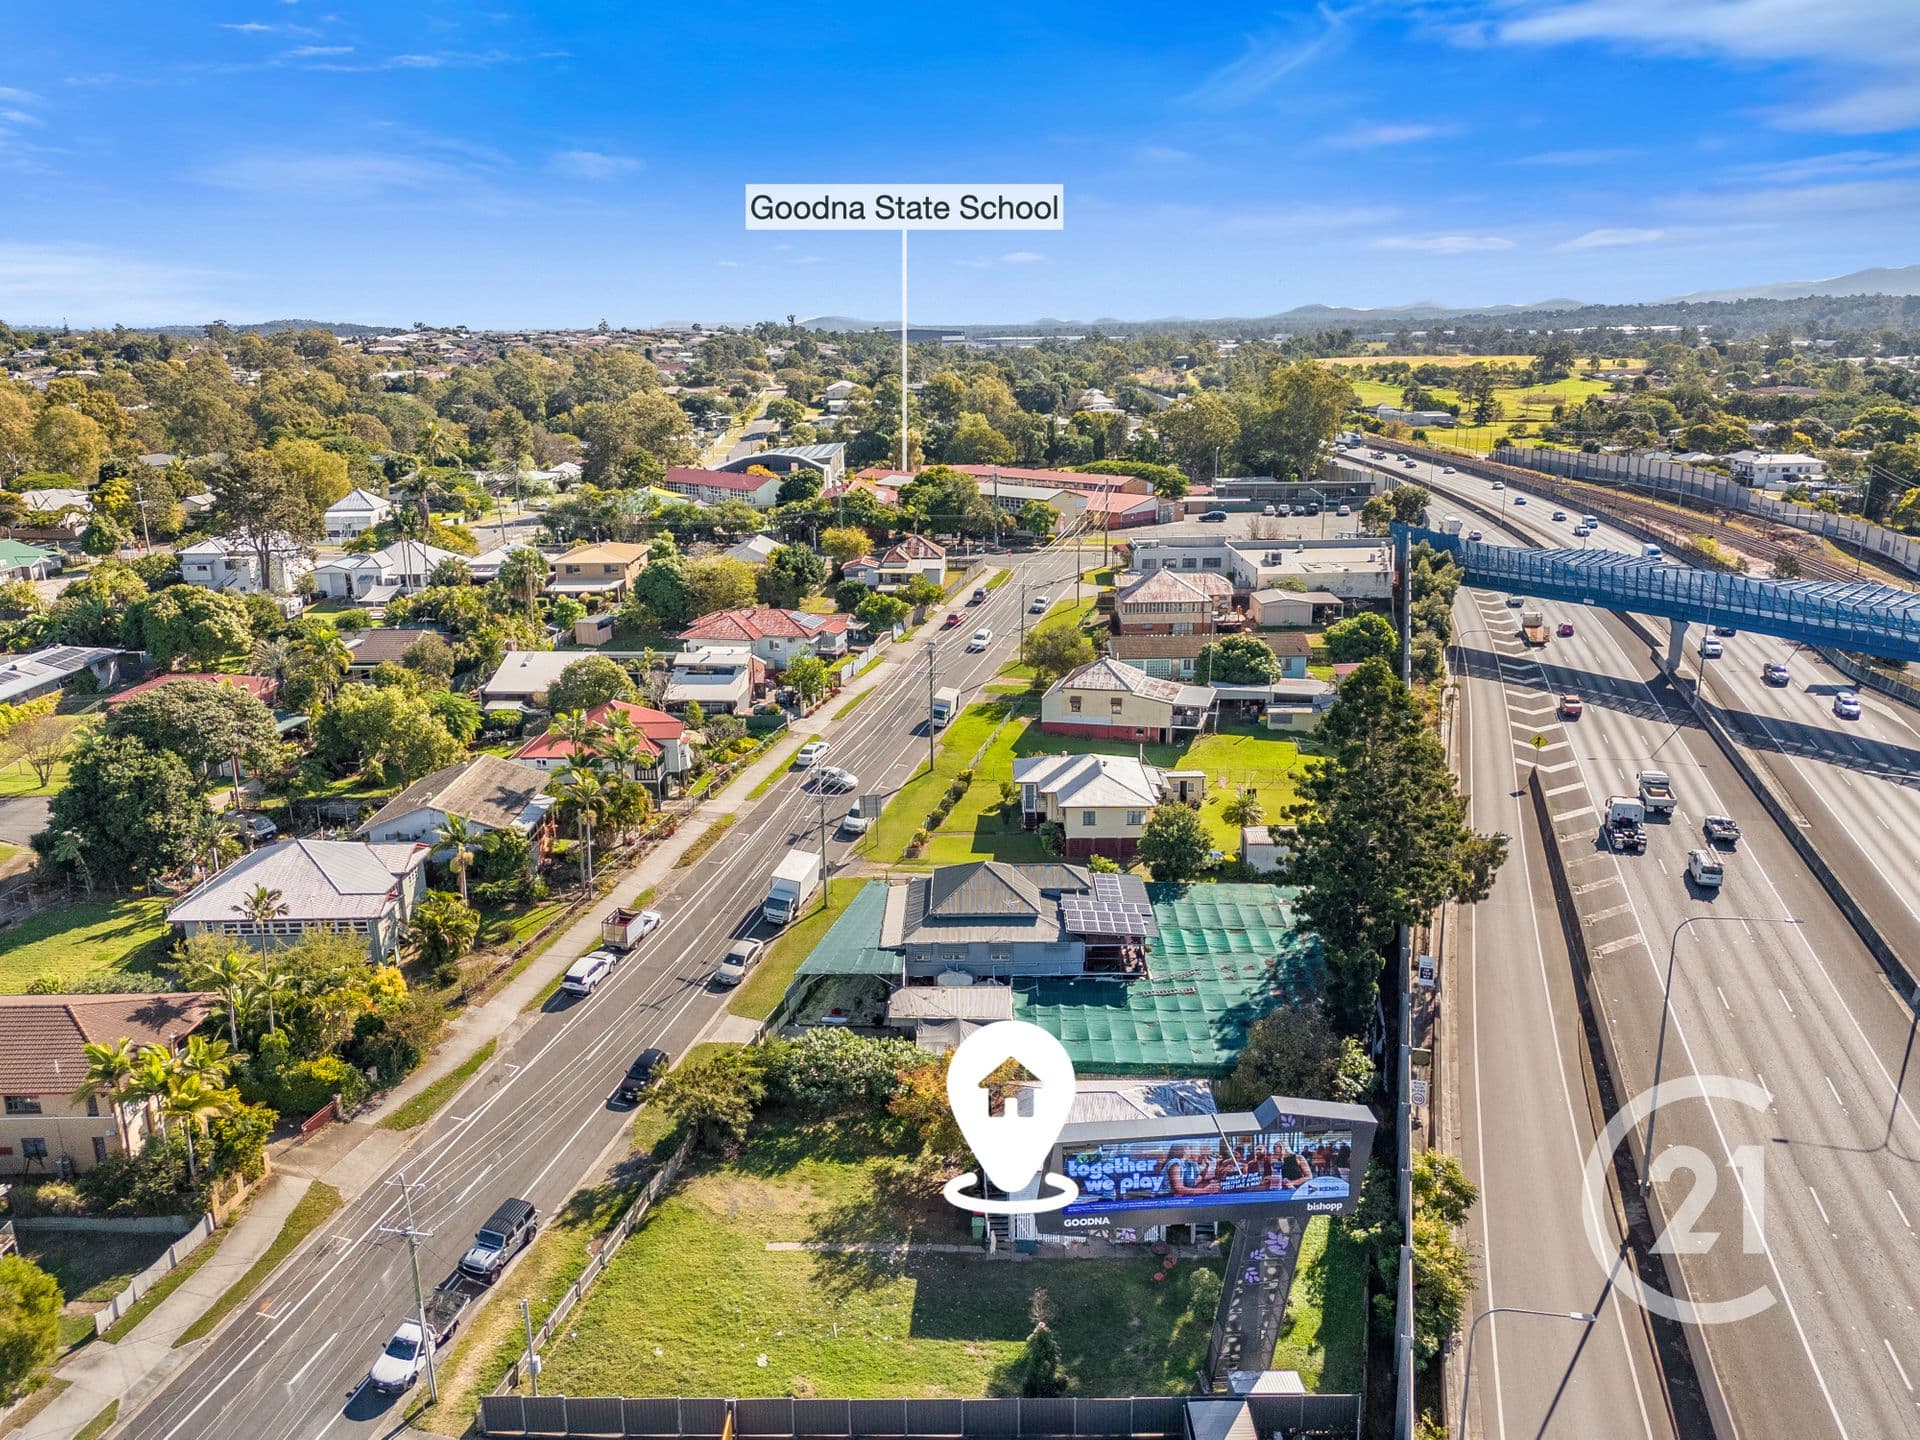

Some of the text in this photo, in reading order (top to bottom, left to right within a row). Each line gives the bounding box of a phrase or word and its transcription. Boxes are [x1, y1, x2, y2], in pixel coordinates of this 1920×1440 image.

[1067, 1156, 1158, 1180] together
[1084, 1173, 1165, 1195] we play
[1306, 1202, 1344, 1212] bishopp
[1063, 1216, 1111, 1228] GOODNA
